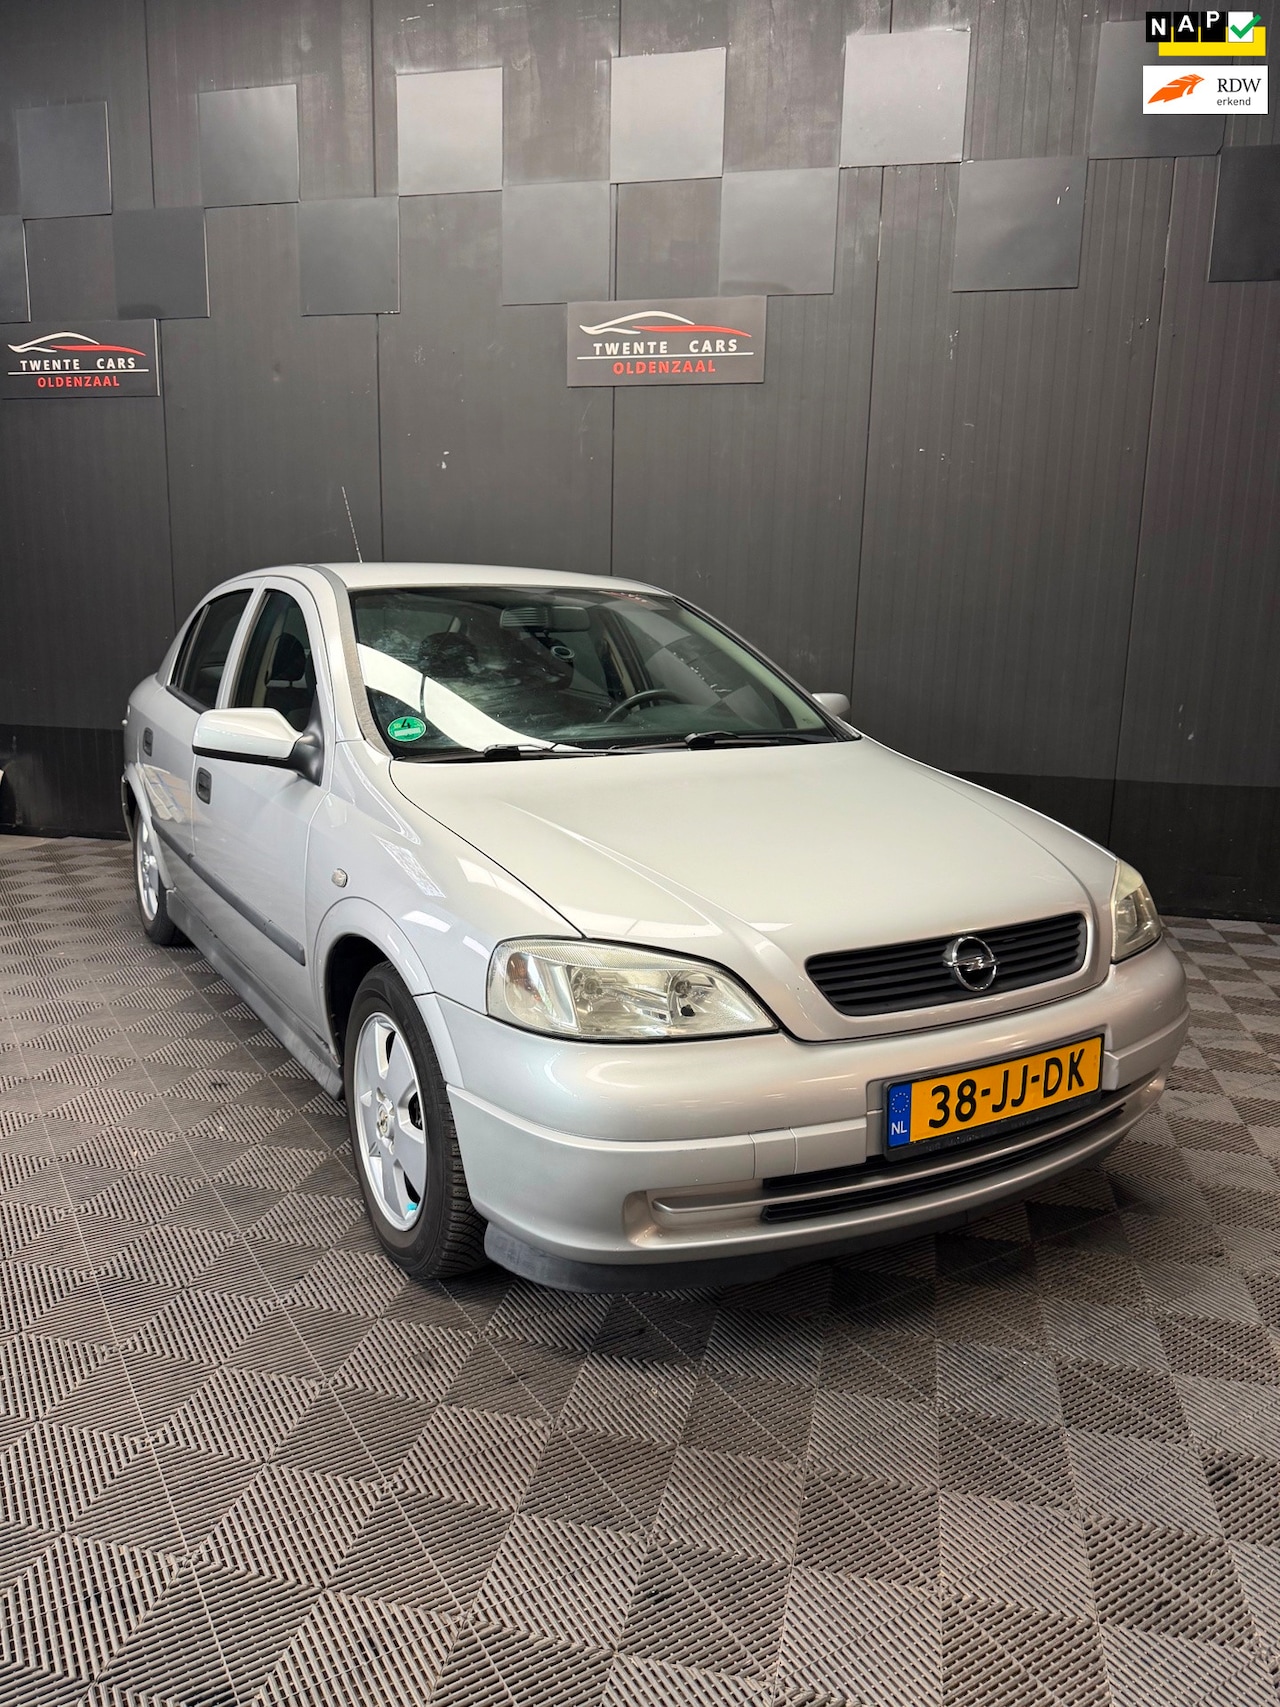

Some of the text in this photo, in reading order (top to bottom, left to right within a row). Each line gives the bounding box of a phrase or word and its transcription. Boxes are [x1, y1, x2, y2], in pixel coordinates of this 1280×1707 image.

[593, 339, 738, 356] TWENTE CARS
[20, 357, 136, 371] TWENTE CARS
[612, 359, 716, 376] OLDENZAAL
[37, 375, 120, 388] OLDENZAAL
[401, 718, 411, 729] 4
[928, 1049, 1085, 1128] 38-JJ-DK
[891, 1120, 908, 1136] NL
